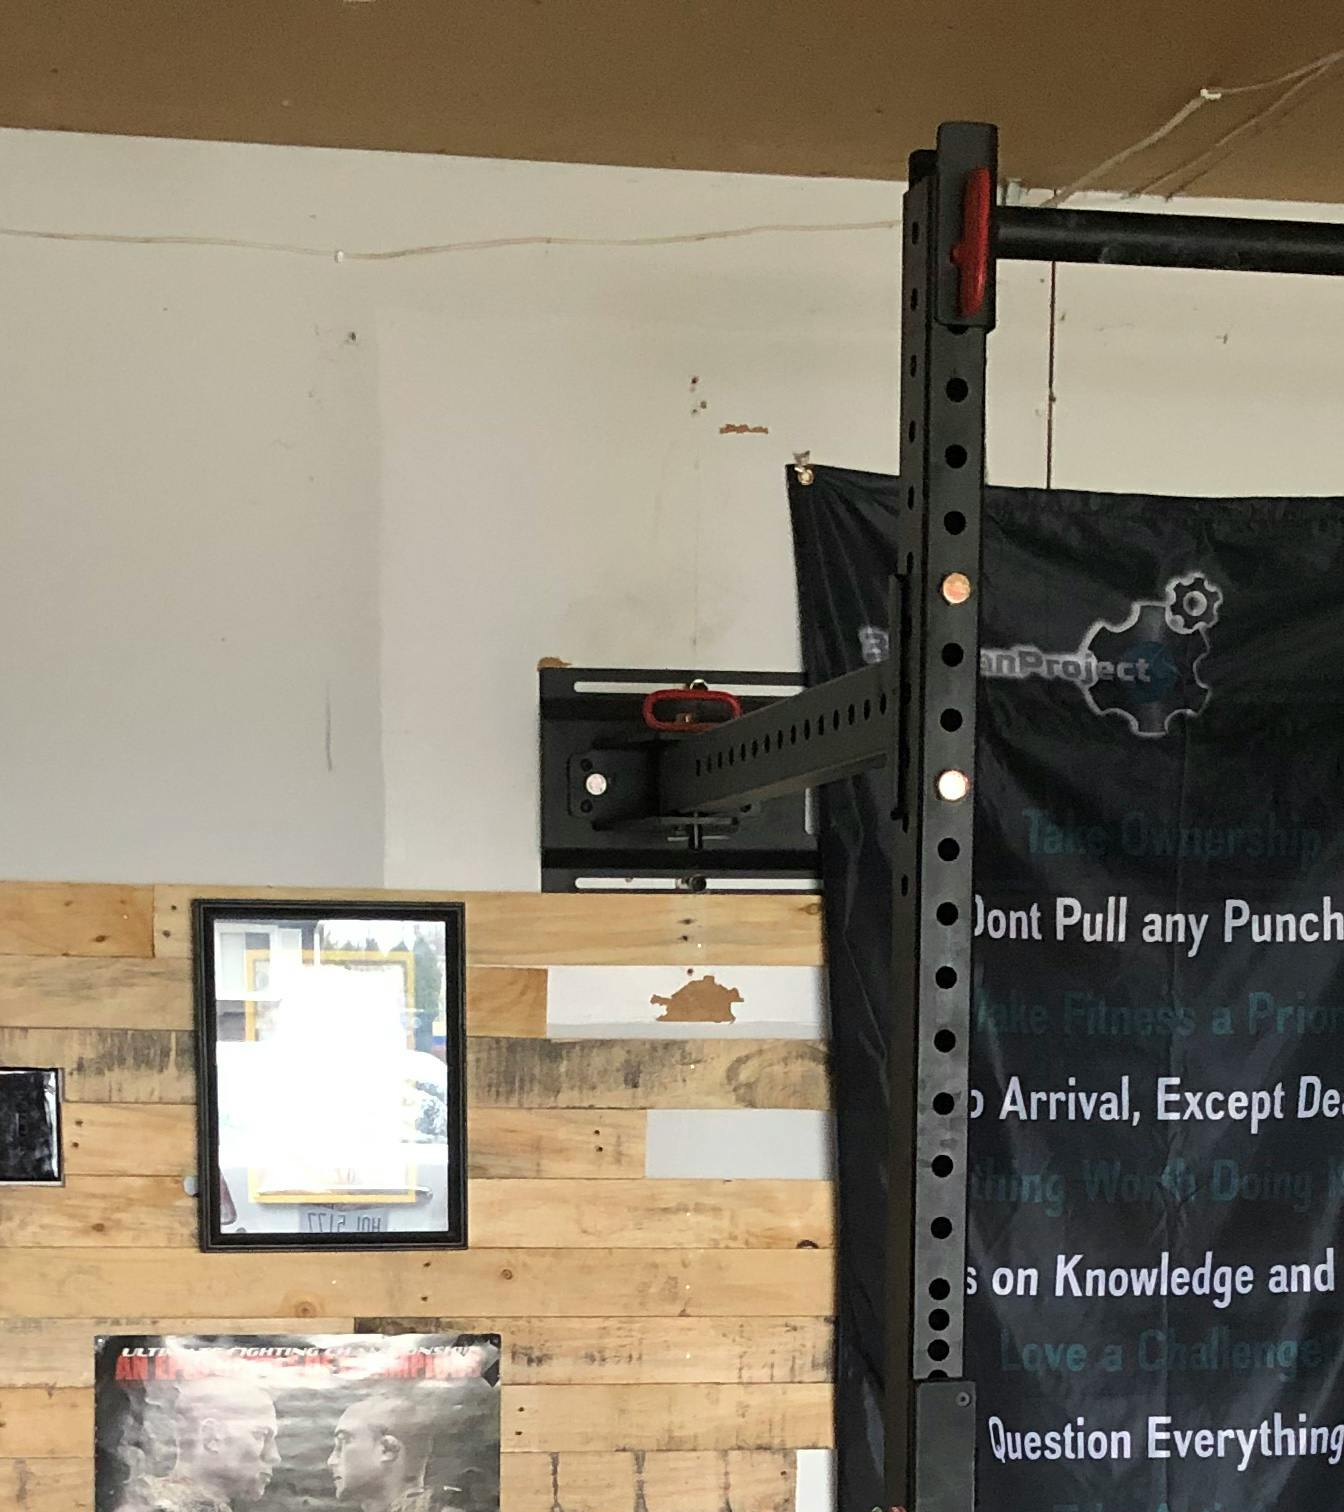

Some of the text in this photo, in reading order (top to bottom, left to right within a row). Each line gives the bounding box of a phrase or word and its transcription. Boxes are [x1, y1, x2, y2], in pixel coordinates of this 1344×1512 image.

[1056, 895, 1127, 943] Pull
[1143, 911, 1209, 957] any
[1063, 990, 1196, 1037] Fitness
[1211, 1005, 1233, 1035] a
[999, 1075, 1141, 1127] Arrival,
[1157, 1075, 1285, 1135] Except
[992, 1266, 1038, 1296] on
[1055, 1251, 1254, 1308] Knowledge
[1268, 1247, 1335, 1294] and
[1000, 1330, 1088, 1373] Love
[988, 1416, 1131, 1463] Question
